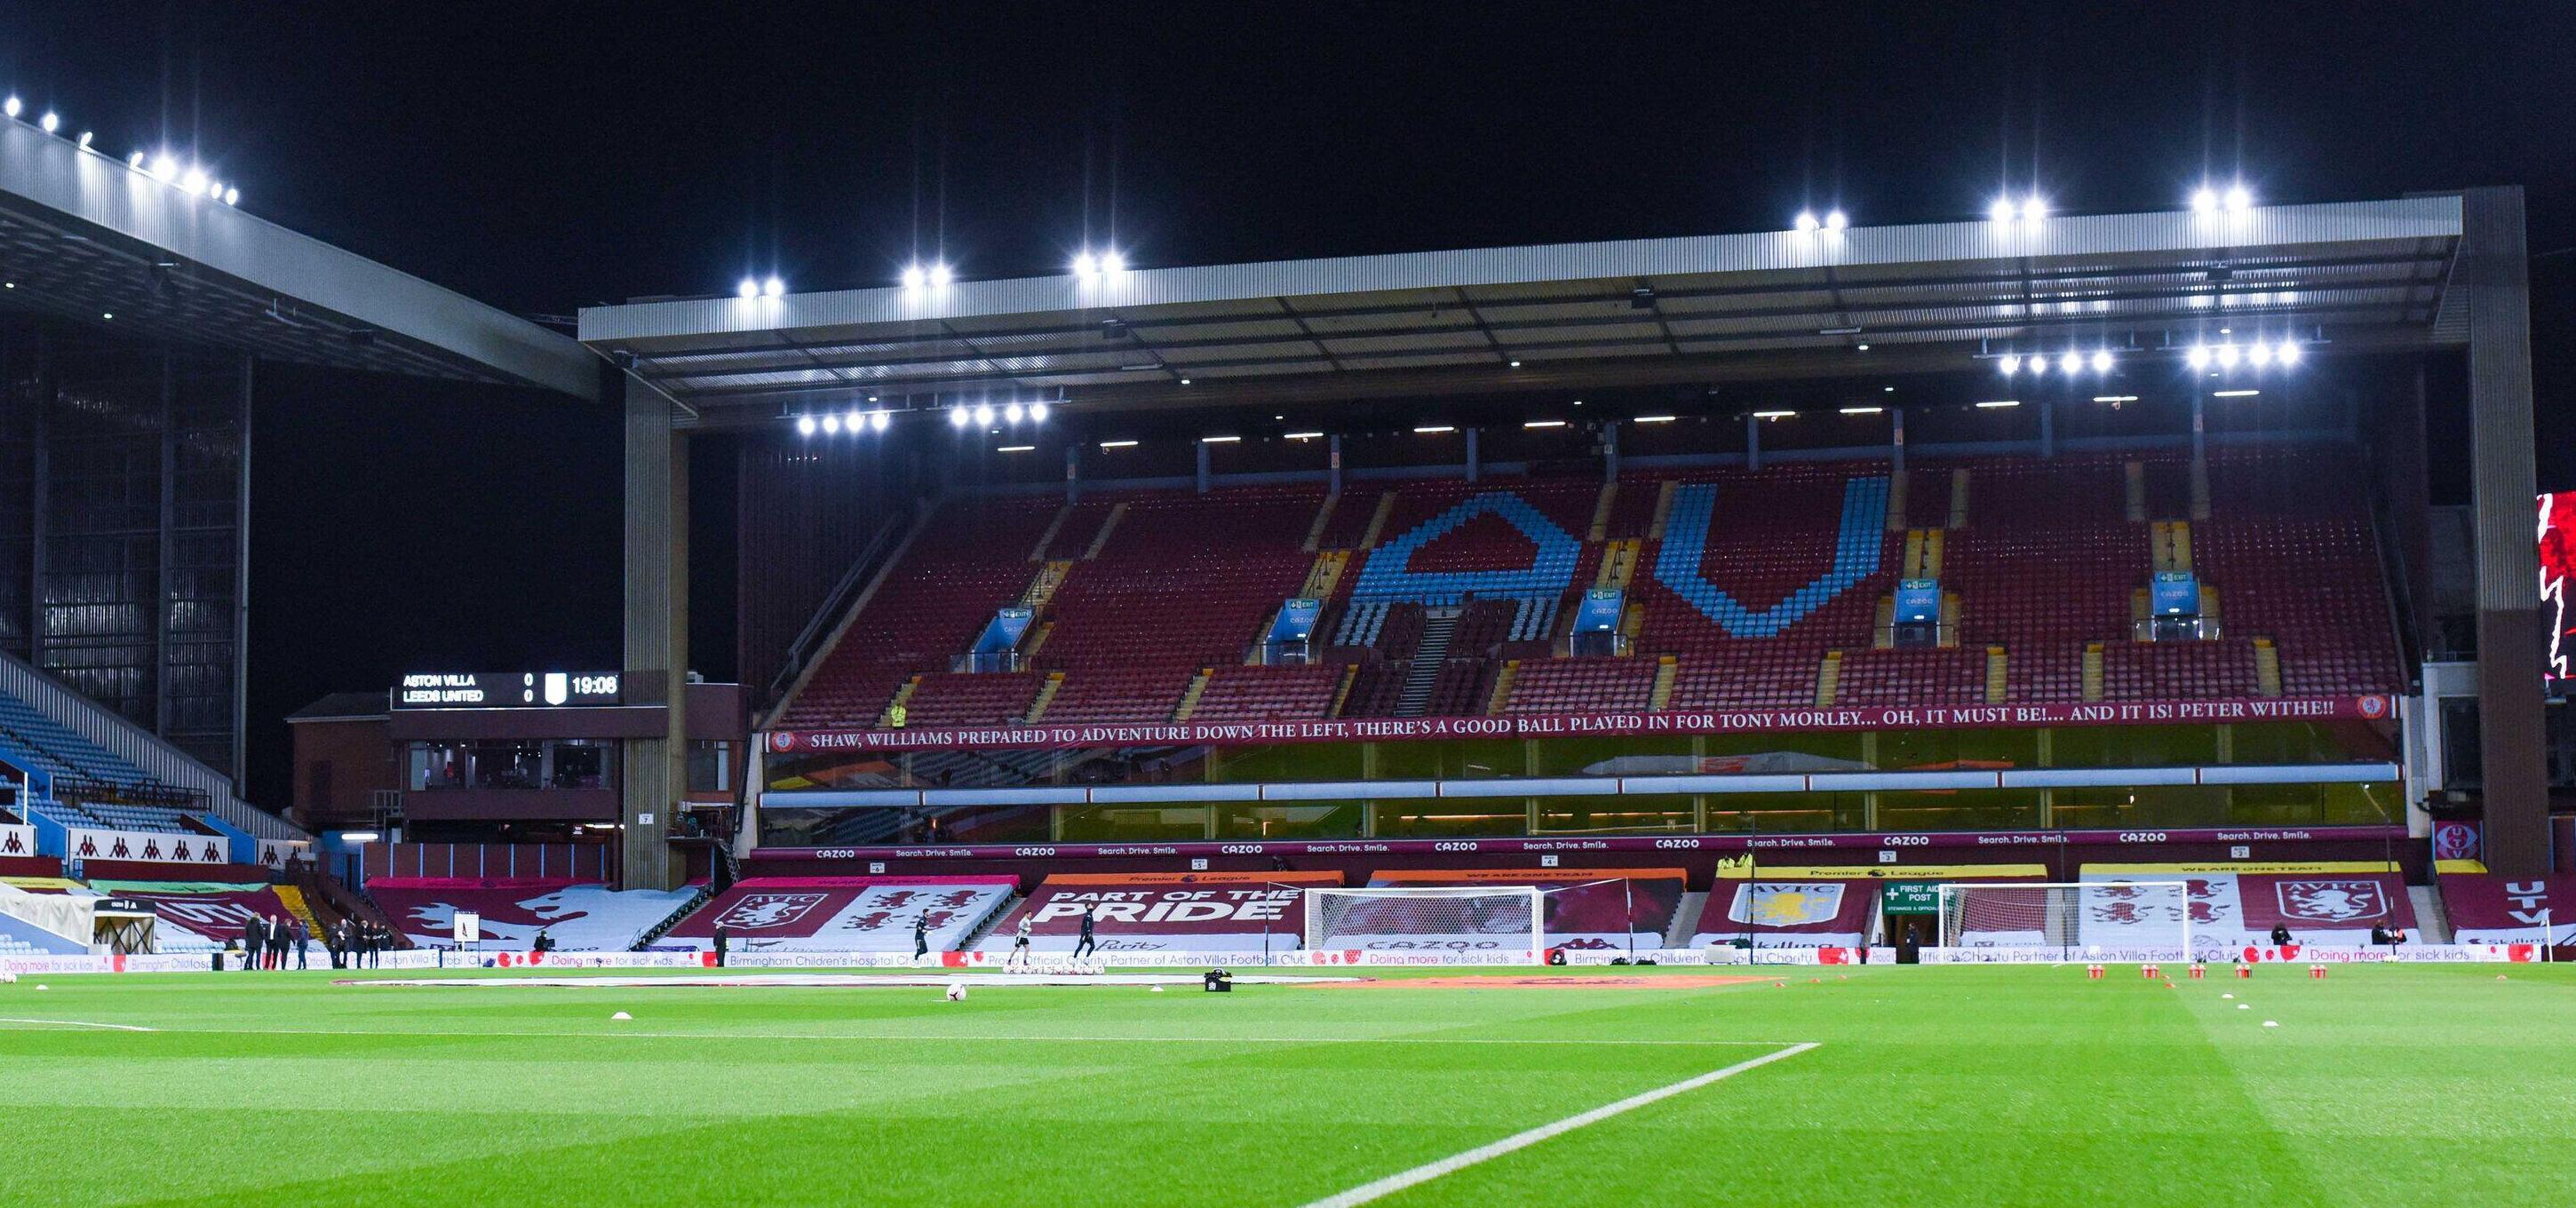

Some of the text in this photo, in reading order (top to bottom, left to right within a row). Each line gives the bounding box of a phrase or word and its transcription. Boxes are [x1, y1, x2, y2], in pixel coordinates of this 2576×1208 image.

[403, 672, 533, 687] ASTON VILLA 0
[572, 676, 617, 694] 19:08
[403, 689, 533, 702] LEEDS UNITED 0
[811, 734, 862, 749] SHAW,
[867, 731, 952, 746] WILLIAMS
[958, 729, 1046, 745] PREPARED
[1052, 728, 1076, 743] TO
[1081, 726, 1190, 743] ADVENTURE
[1196, 725, 1253, 740] DOWN
[1259, 724, 1296, 738] THE
[1301, 722, 1349, 738] LEFT,
[1435, 719, 1448, 734] A
[1453, 719, 1511, 734] GOOD
[1517, 718, 1564, 732] BALL
[1570, 716, 1642, 731] PLAYED
[1648, 715, 1670, 729] IN
[1675, 714, 1715, 728] FOR
[1721, 713, 1774, 728] TONY
[1778, 711, 1877, 727] MORLEY...
[1882, 710, 1920, 726] OH,
[1926, 709, 1947, 723] IT
[1952, 708, 2010, 723] MUST
[2016, 706, 2063, 722] BE!...
[2071, 705, 2115, 721] AND
[2120, 704, 2143, 719] IT
[2148, 703, 2174, 719] IS!
[2179, 702, 2246, 718] PETER
[2250, 700, 2334, 717] WITHE!!
[816, 850, 855, 859] CAZOO
[1015, 847, 1055, 856] CAZOO
[1221, 845, 1262, 854] CAZOO
[1339, 844, 1362, 853] Drive.
[1435, 842, 1477, 851] CAZOO
[1656, 839, 1699, 848] CAZOO
[1884, 837, 1929, 846] CAZOO
[2013, 835, 2039, 844] Drive.
[2119, 833, 2167, 842] CAZOO
[2254, 831, 2280, 840] Drive.
[1049, 890, 1300, 902] PART OF THE
[1030, 901, 1292, 923] PRIDE
[1094, 939, 1167, 951] Purity
[552, 955, 583, 967] Doing
[616, 956, 629, 966] for
[632, 956, 650, 966] sick
[654, 955, 673, 966] kids
[730, 956, 792, 967] Birmingham
[851, 955, 894, 967] Hospital
[1111, 955, 1151, 966] Partner
[1155, 955, 1166, 966] of
[1170, 955, 1201, 966] Aston
[1204, 954, 1228, 965] Villa
[1231, 954, 1277, 966] Football
[1281, 954, 1306, 965] Club
[1370, 953, 1509, 966] Doing more for sick kids
[1575, 953, 1646, 965] Birminm
[1650, 952, 1705, 964] Children'
[1767, 953, 1812, 966] Charity
[2014, 950, 2057, 962] Partner
[2063, 950, 2076, 961] of
[2119, 950, 2147, 961] Villa
[2310, 950, 2349, 962] Doing
[2415, 949, 2440, 960] sick
[2444, 949, 2469, 960] kids
[4, 959, 28, 973] Doing
[29, 961, 49, 971] more
